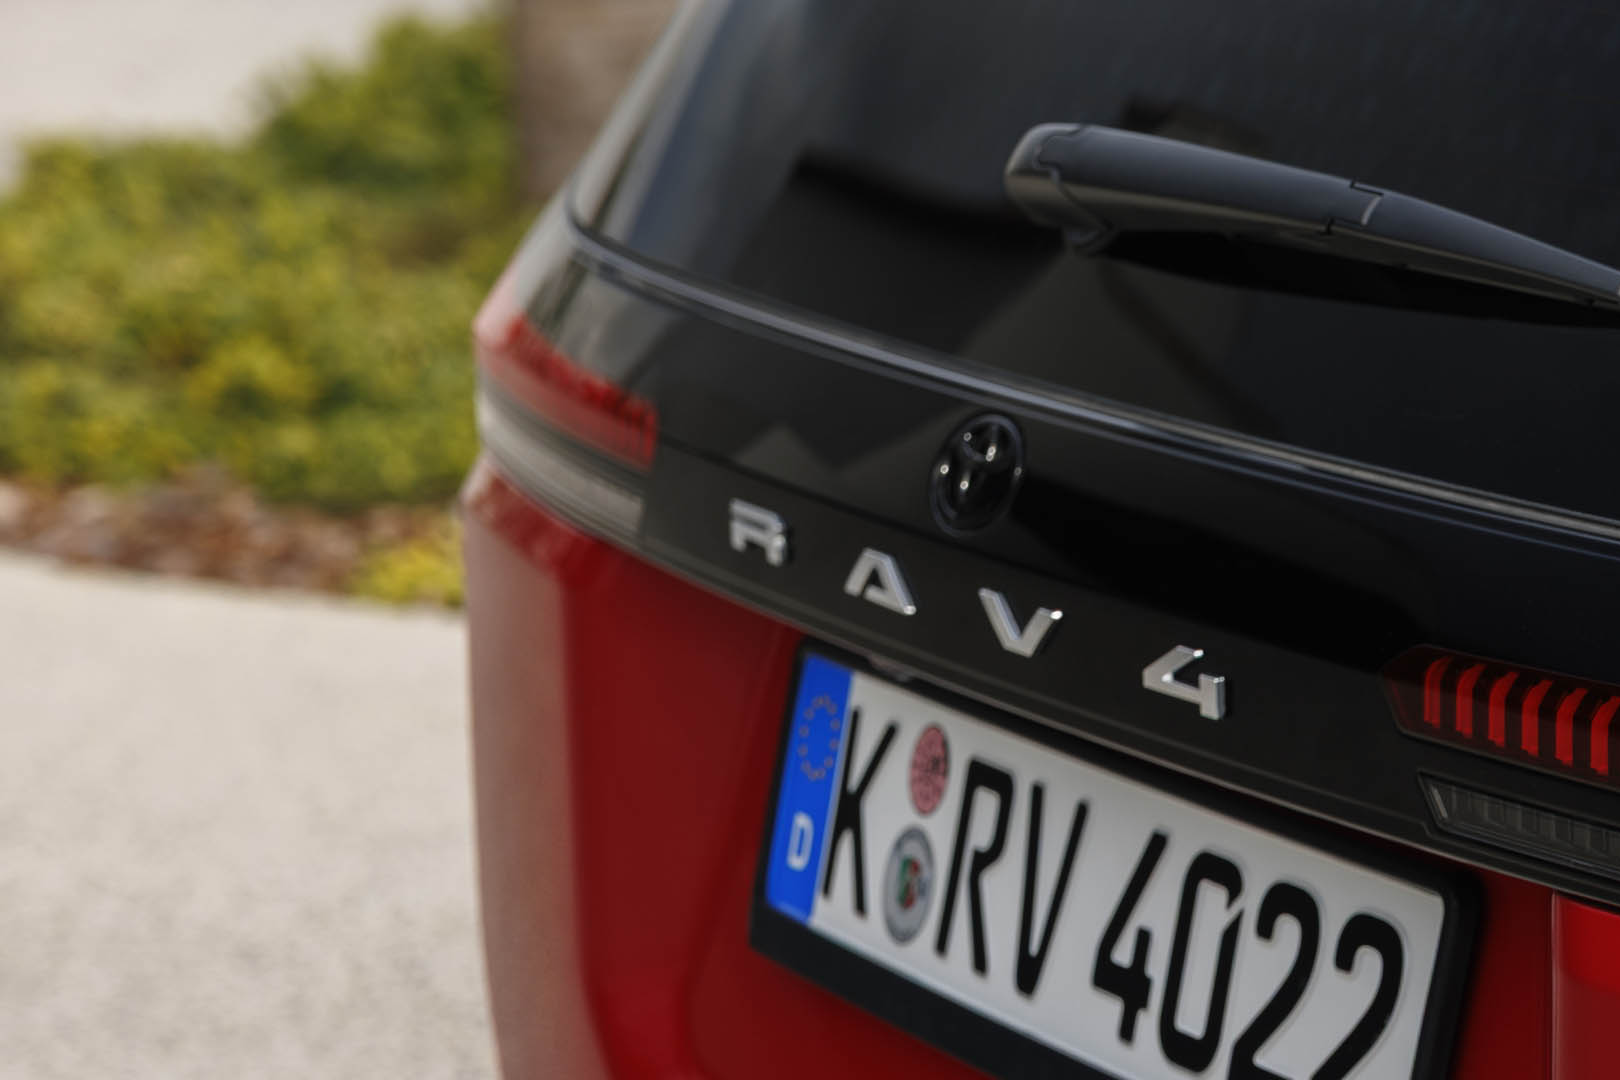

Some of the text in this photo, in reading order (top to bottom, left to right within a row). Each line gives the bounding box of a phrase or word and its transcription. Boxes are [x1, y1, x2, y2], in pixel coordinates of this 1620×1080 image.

[787, 811, 814, 870] D
[823, 706, 899, 918] K
[935, 758, 1090, 998] RV
